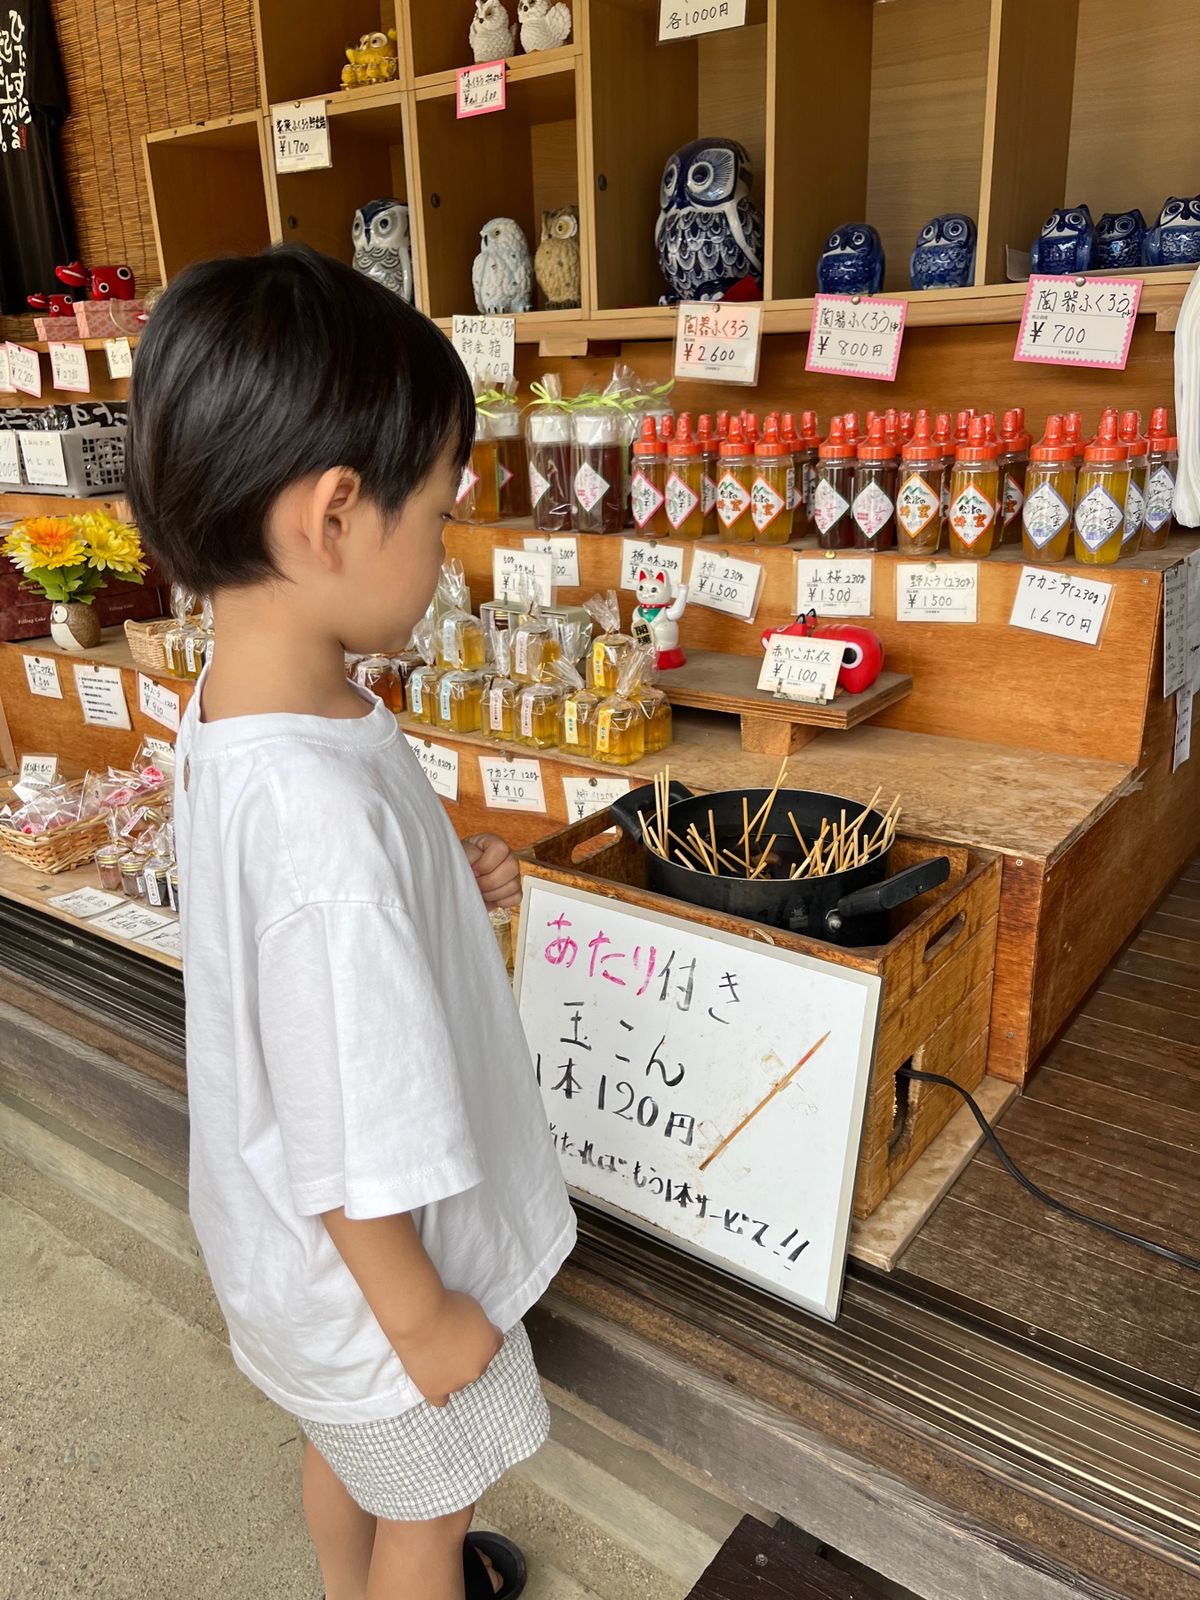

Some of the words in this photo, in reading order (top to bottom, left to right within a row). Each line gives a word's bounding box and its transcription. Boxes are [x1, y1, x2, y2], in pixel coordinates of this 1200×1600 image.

[666, 2, 728, 29] 各1000円
[684, 314, 749, 338] 陶器ふくろう
[544, 912, 741, 1025] あたり付き
[560, 1001, 685, 1087] 玉こん
[598, 1074, 696, 1146] 120円
